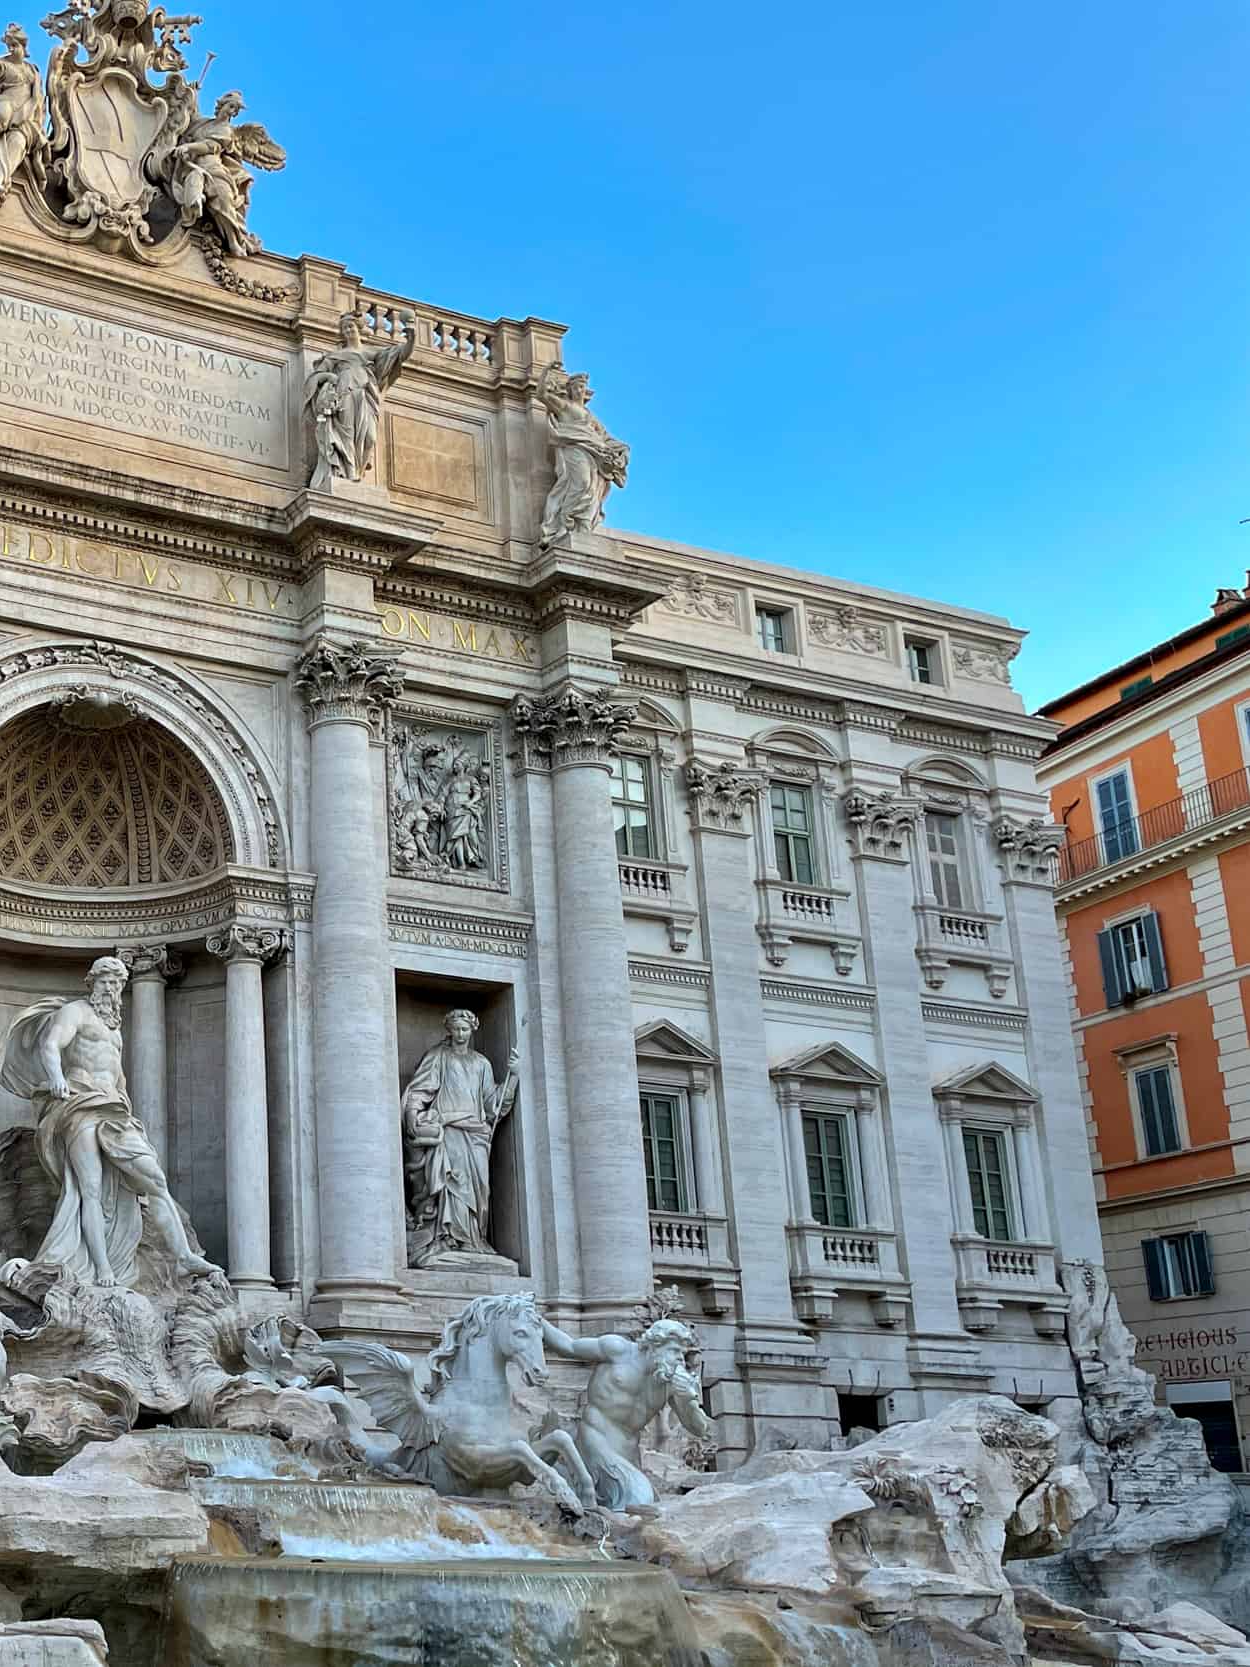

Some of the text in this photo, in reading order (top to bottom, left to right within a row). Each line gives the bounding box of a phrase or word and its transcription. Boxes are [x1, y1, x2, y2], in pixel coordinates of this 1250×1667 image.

[24, 329, 187, 382] AQVAM VIRGINEM
[18, 347, 130, 385] SALVBRITATE
[140, 377, 270, 421] COMMENDATAM
[47, 372, 146, 408] MAGNIFICO
[154, 399, 230, 429] ORNAVIT
[160, 917, 190, 933] OPVS
[195, 911, 221, 927] CVM
